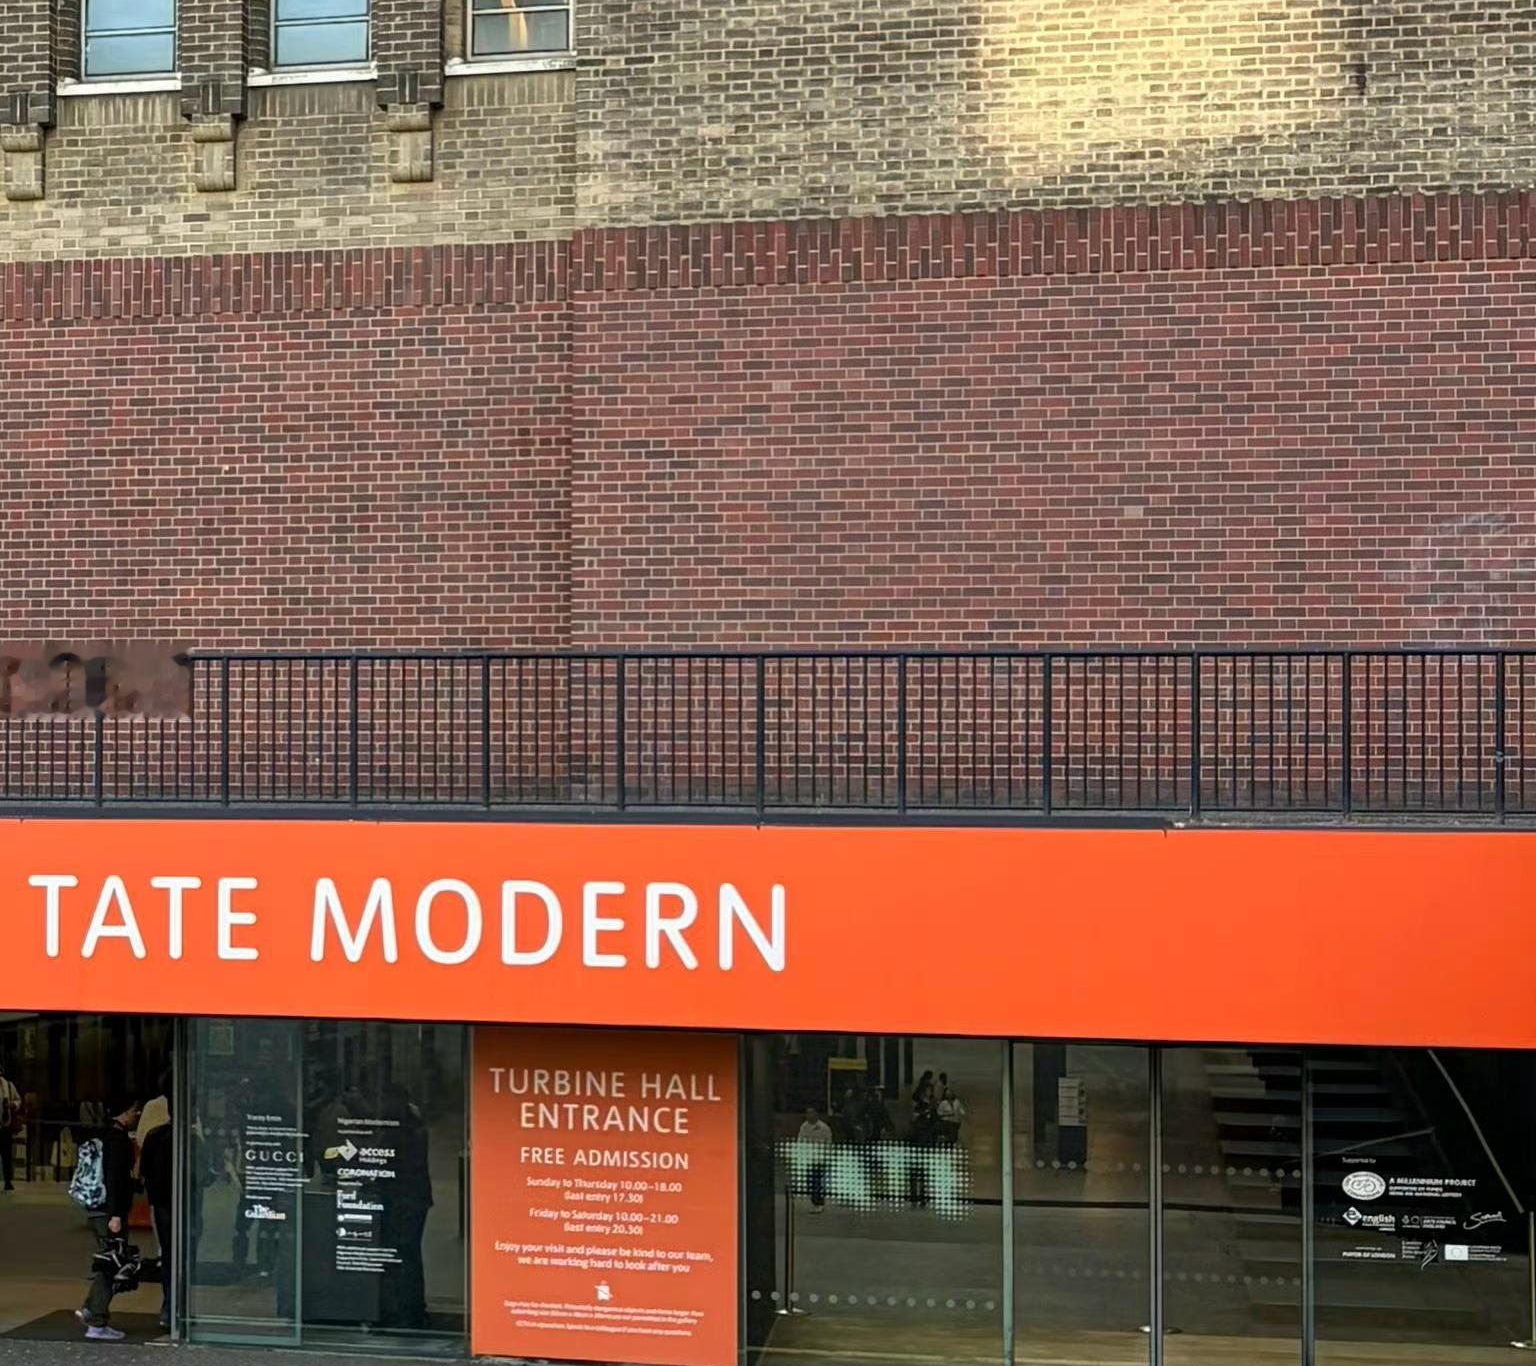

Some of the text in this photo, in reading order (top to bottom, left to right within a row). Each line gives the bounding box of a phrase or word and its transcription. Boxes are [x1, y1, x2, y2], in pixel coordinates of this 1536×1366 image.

[28, 875, 260, 960] TATE
[309, 877, 786, 971] MODERN
[489, 1067, 721, 1102] TURBINE HALL
[520, 1102, 689, 1134] ENTRANCE
[245, 1149, 304, 1163] GUCCI
[359, 1147, 396, 1158] access
[520, 1146, 689, 1170] FREE ADMISSION
[526, 1176, 560, 1189] Sunday
[563, 1178, 573, 1188] to
[574, 1178, 618, 1191] Thursday
[1389, 1177, 1396, 1185] A
[1444, 1178, 1477, 1187] PROJECT
[585, 1192, 611, 1203] entry
[529, 1208, 558, 1220] Friday
[560, 1209, 570, 1219] to
[571, 1209, 613, 1222] Saturday
[585, 1223, 611, 1235] entry
[495, 1241, 713, 1262] Enjoy your visit and please be kind to our team,
[518, 1256, 690, 1273] we are working hard to look after you
